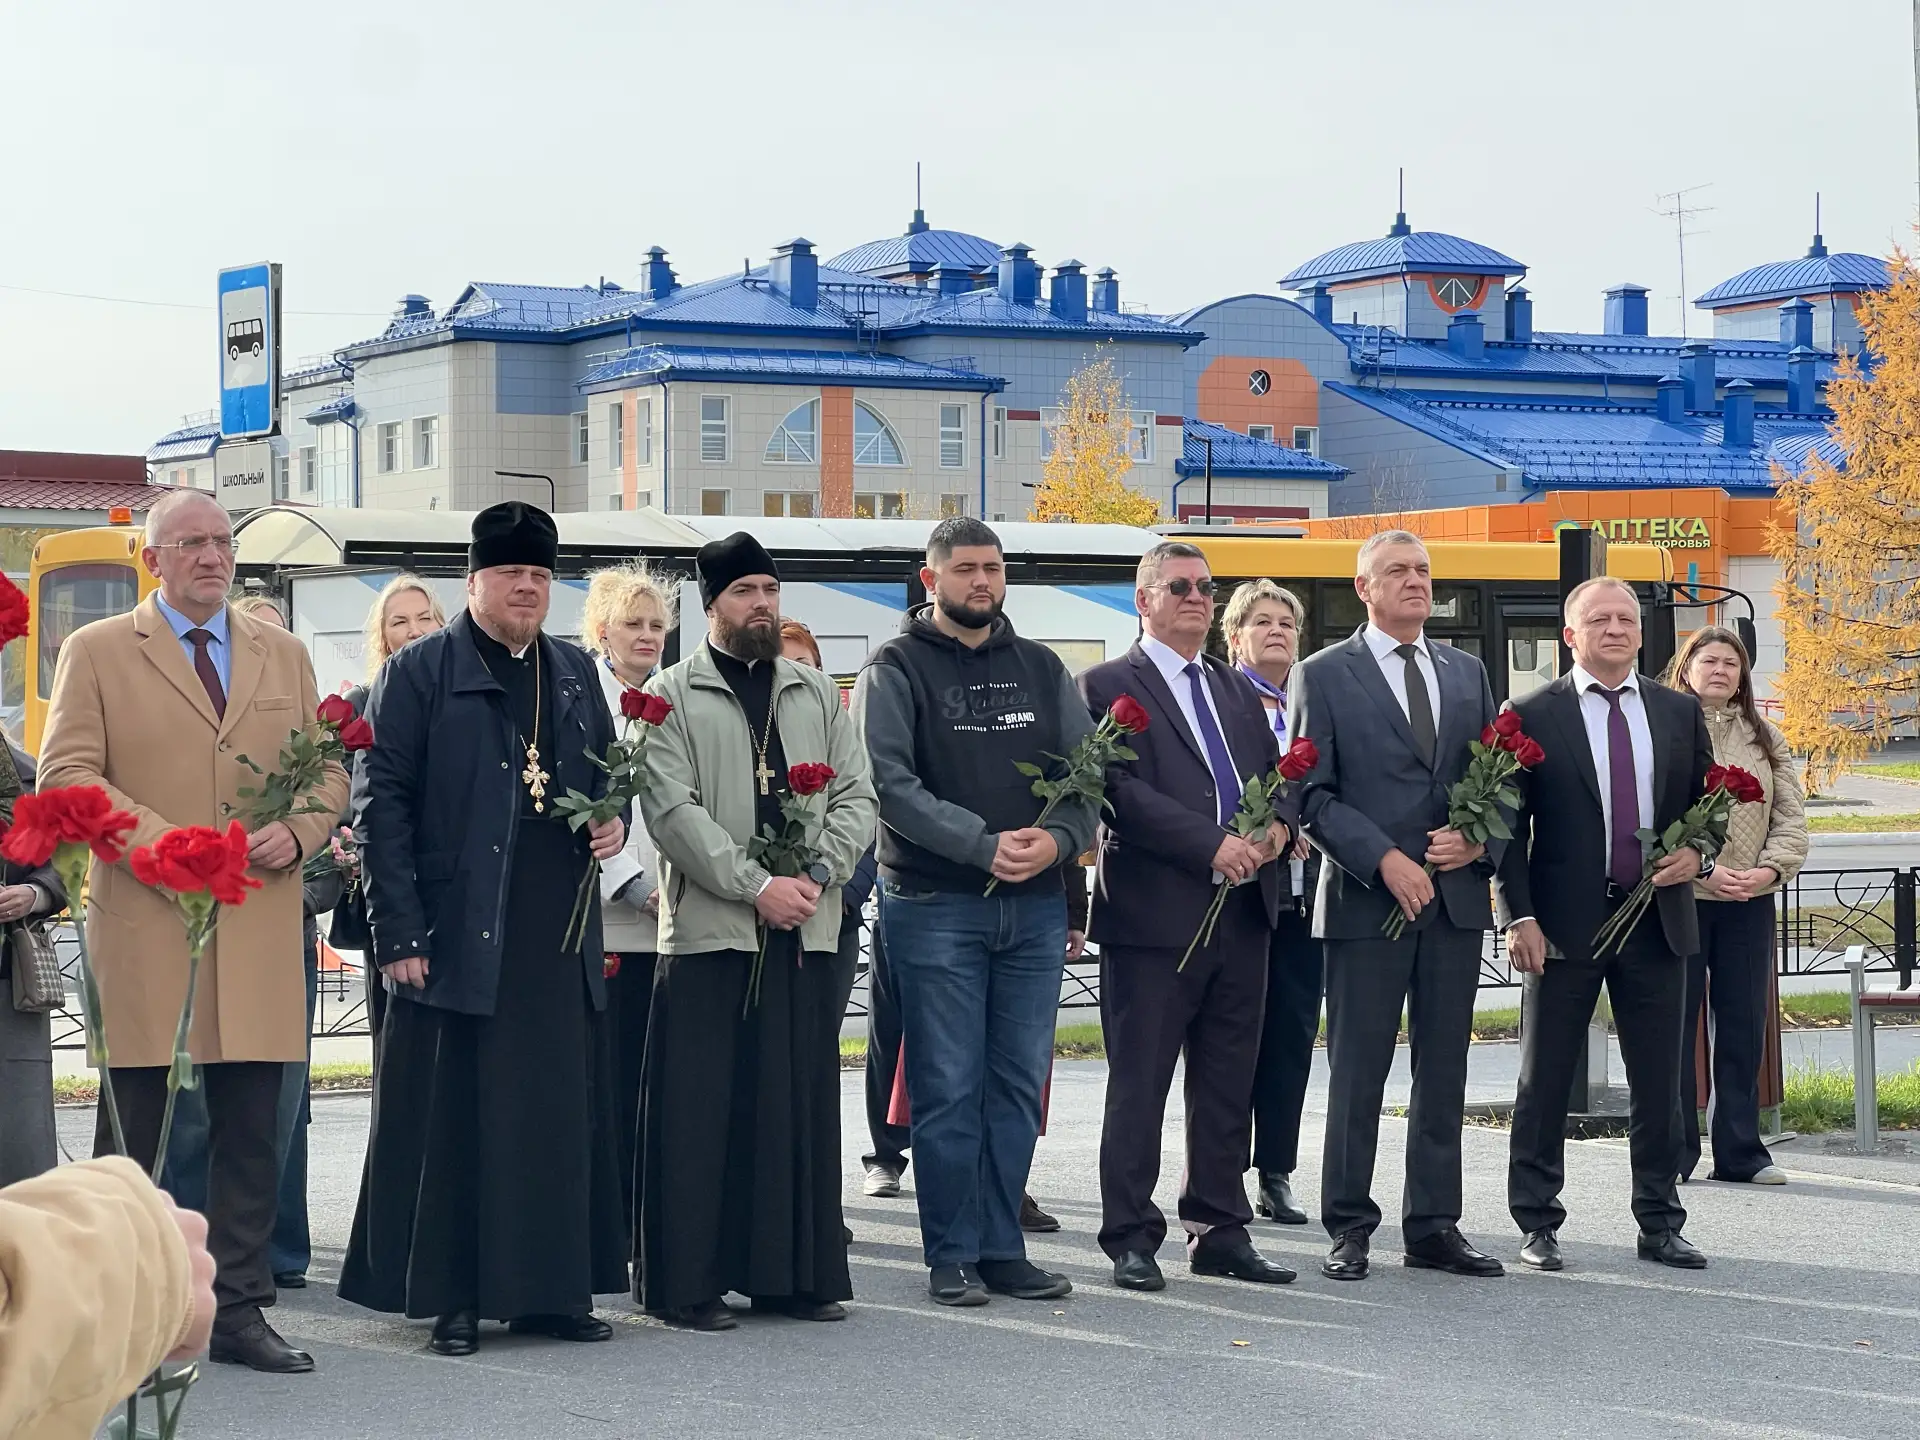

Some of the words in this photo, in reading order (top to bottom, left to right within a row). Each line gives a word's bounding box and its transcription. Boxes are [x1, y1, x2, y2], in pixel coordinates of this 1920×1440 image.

[223, 468, 264, 487] ШКОЛЬНЫЙ
[1591, 518, 1709, 538] АПТЕКА
[1004, 712, 1035, 724] BRAND
[992, 723, 1027, 731] TRADEMARK
